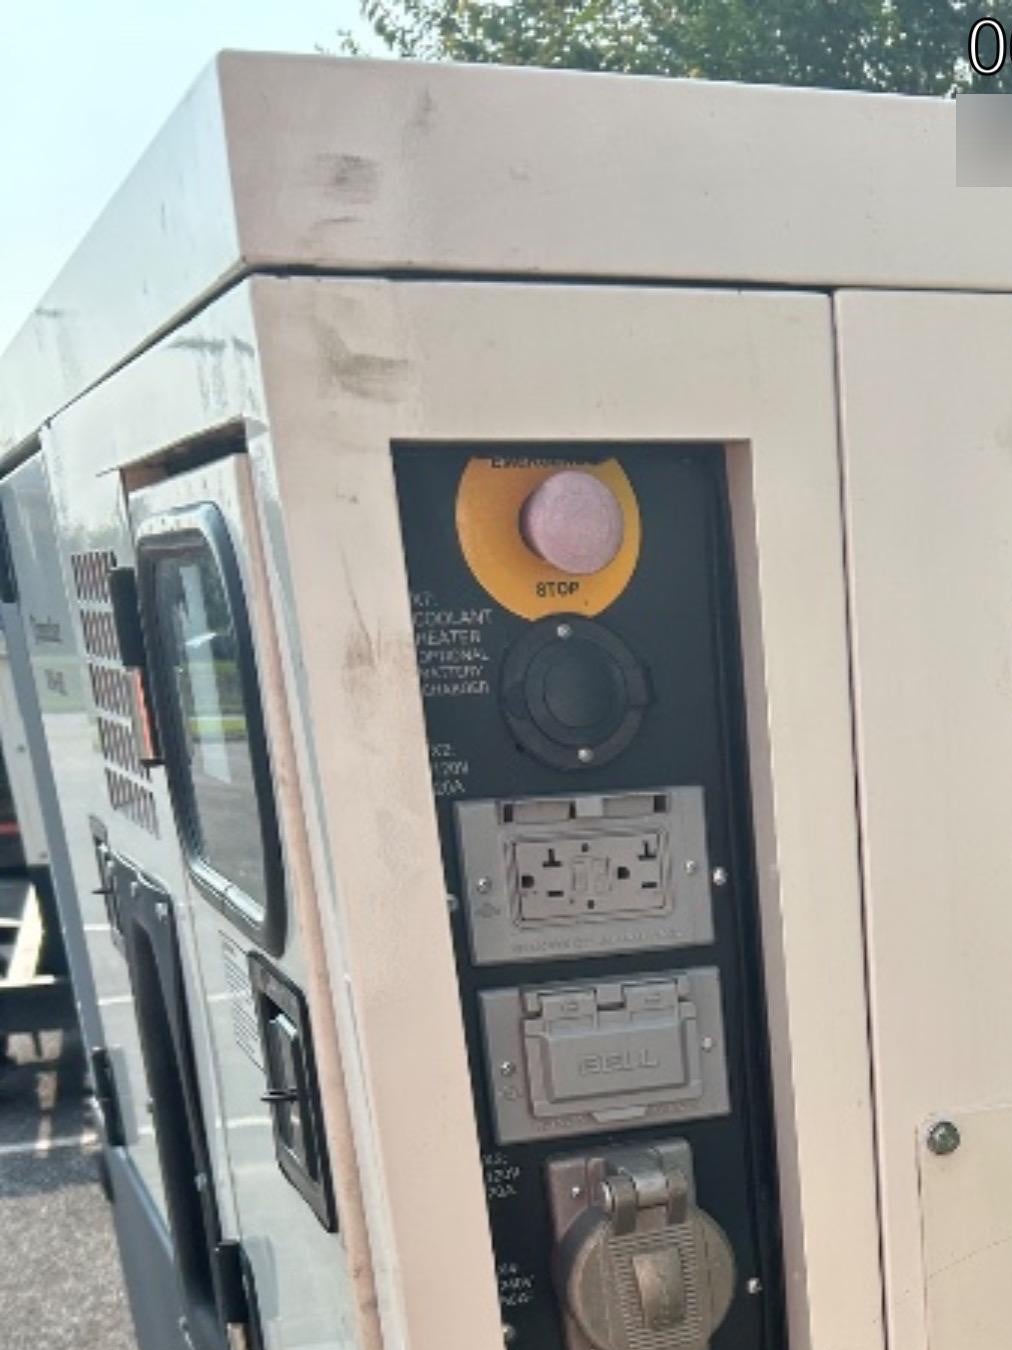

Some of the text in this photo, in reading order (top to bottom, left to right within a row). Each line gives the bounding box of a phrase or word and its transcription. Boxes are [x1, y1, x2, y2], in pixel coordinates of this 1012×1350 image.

[536, 581, 579, 598] STOP
[413, 608, 492, 628] COOLANT
[416, 629, 481, 646] HEATER
